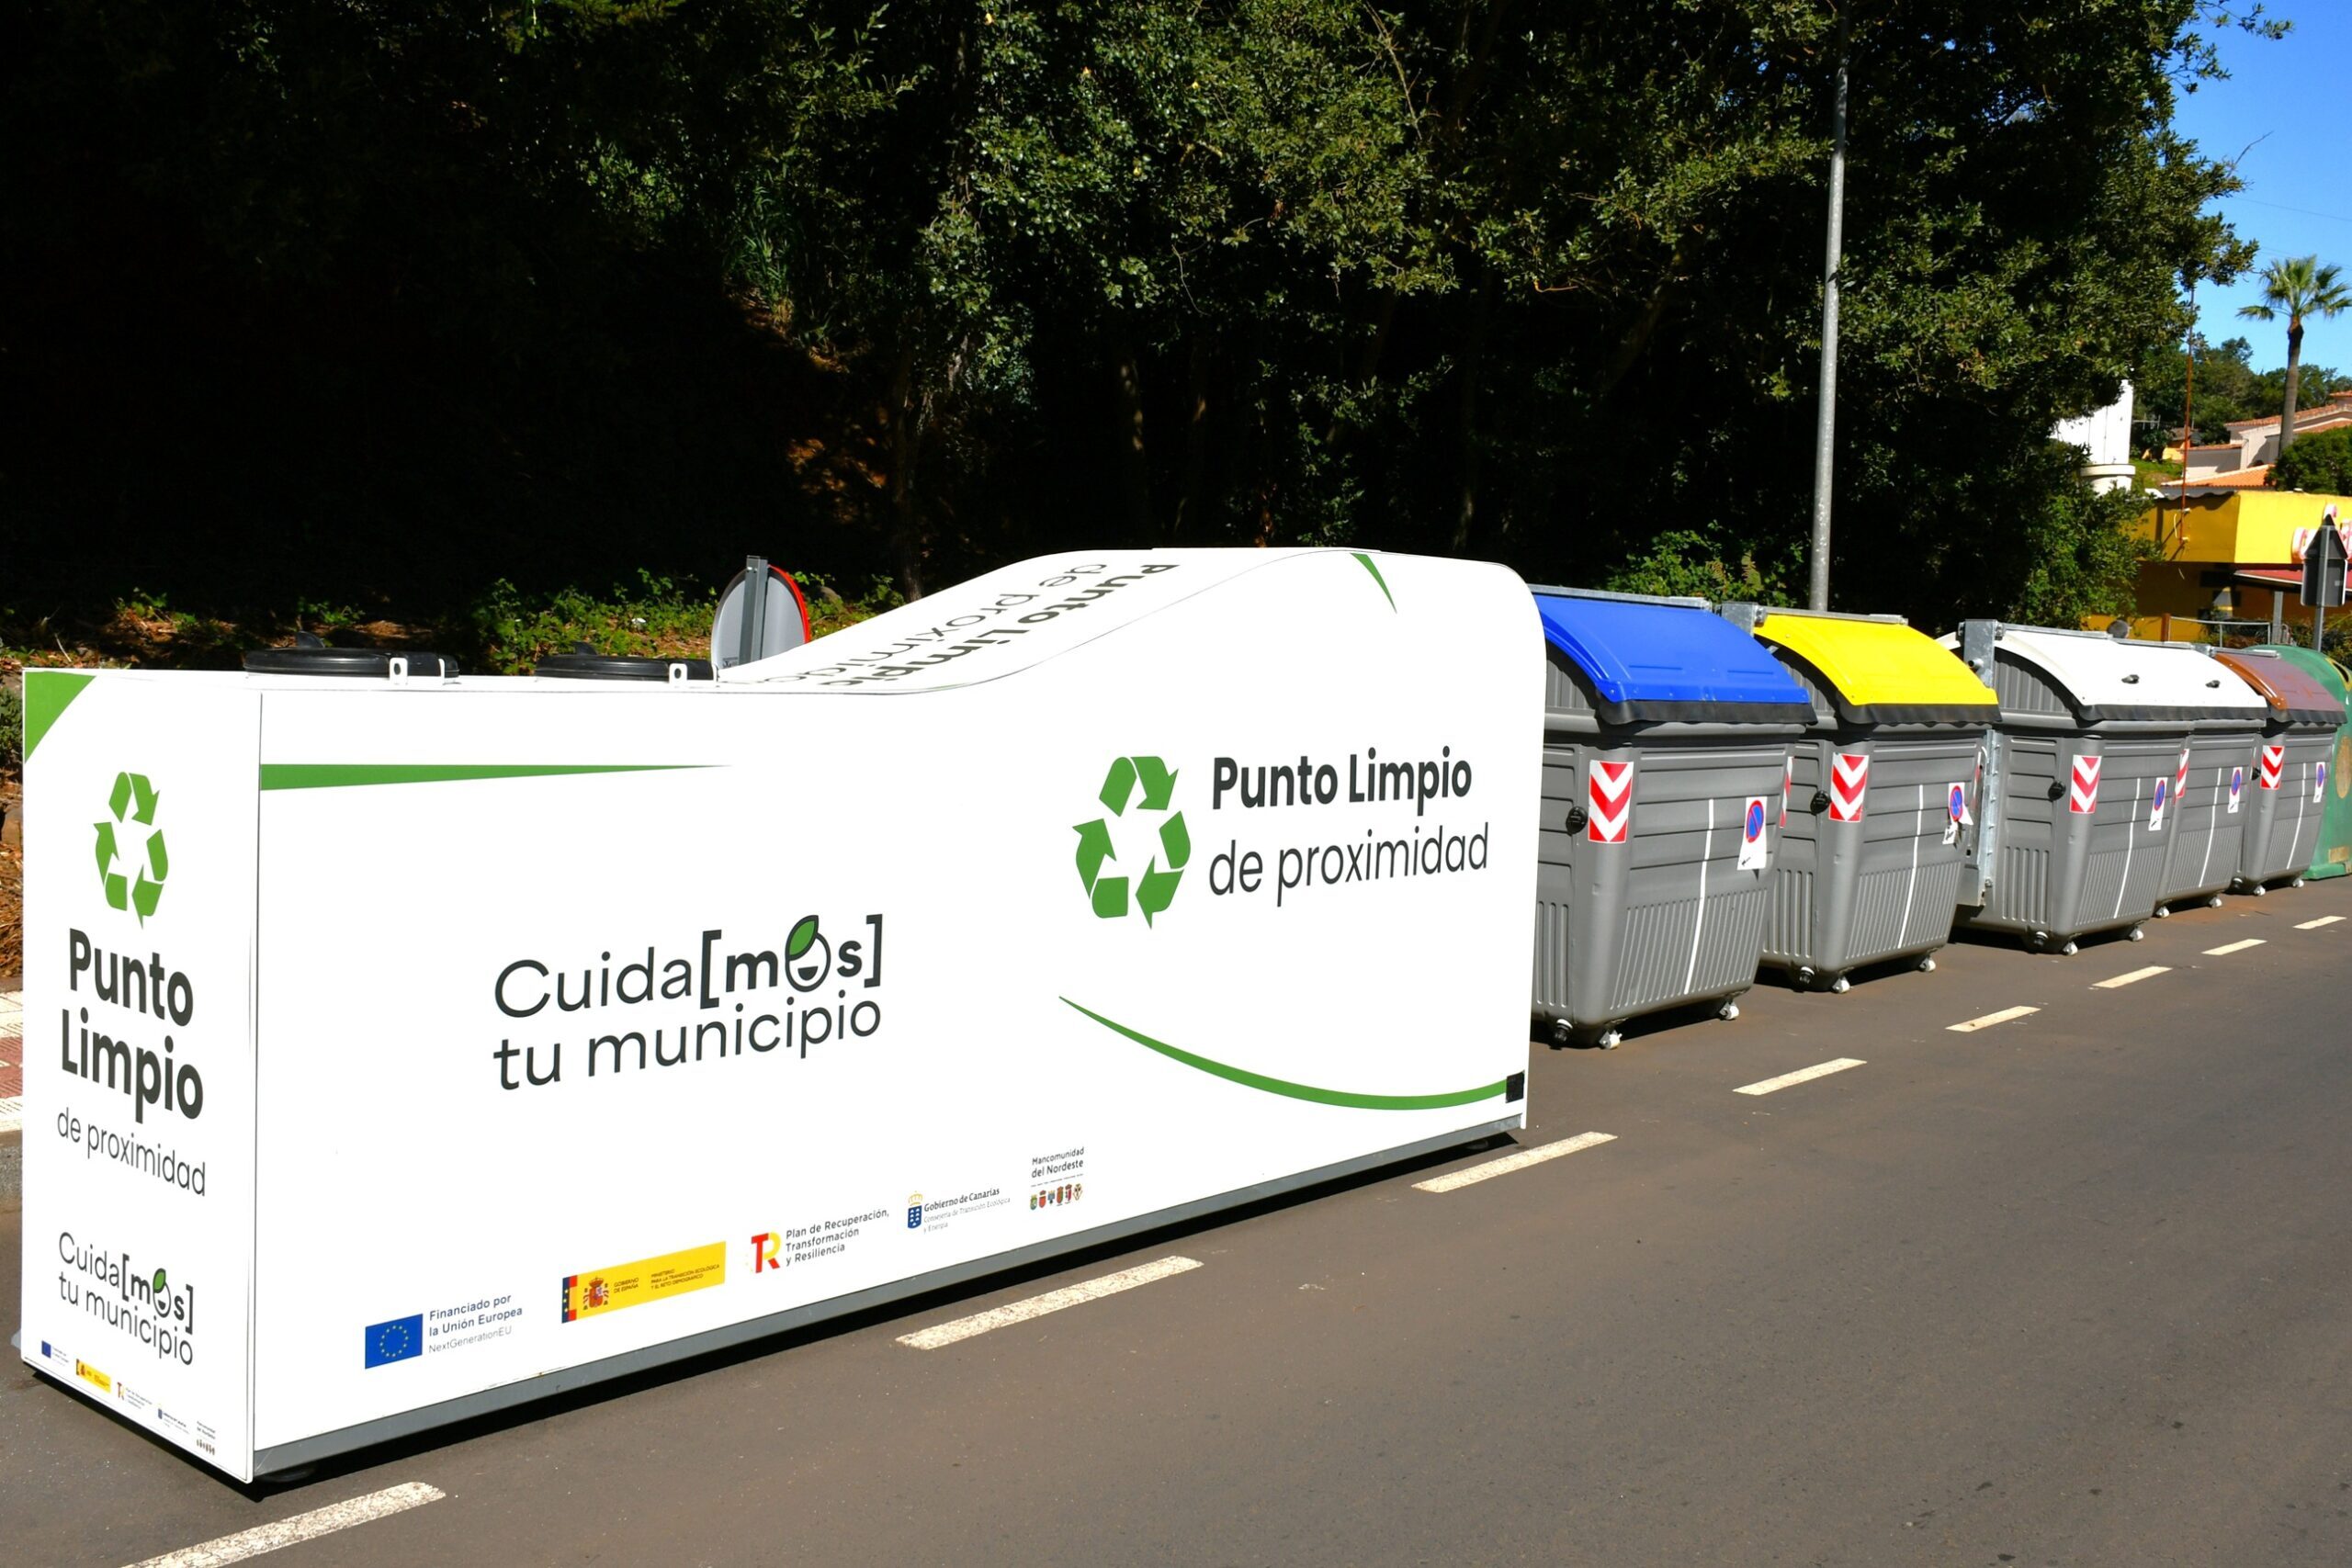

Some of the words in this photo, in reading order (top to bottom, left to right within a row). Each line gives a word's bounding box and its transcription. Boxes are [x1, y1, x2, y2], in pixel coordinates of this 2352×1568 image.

[1038, 564, 1107, 587] de
[1017, 564, 1181, 624] Punto
[1213, 756, 1339, 810] Punto
[1350, 746, 1472, 817] Limpio
[1209, 840, 1263, 896] de
[1277, 821, 1488, 908] proximidad
[70, 928, 194, 1027] Punto
[493, 1039, 560, 1090] tu
[588, 989, 881, 1077] municipio
[62, 1007, 204, 1124] Limpio
[57, 1107, 82, 1143] de
[87, 1123, 206, 1197] proximidad
[1032, 1146, 1084, 1166] Mancomunidad
[1031, 1167, 1045, 1179] del
[1046, 1159, 1084, 1175] Nordeste
[924, 1198, 958, 1213] Gobierno
[959, 1194, 968, 1203] de
[968, 1188, 1000, 1201] Canarias
[786, 1229, 807, 1240] Plan
[809, 1224, 821, 1235] de
[824, 1209, 889, 1231] Recuperación,
[786, 1227, 860, 1252] Transformación
[786, 1257, 792, 1267] y
[795, 1243, 845, 1263] Resiliencia
[58, 1270, 79, 1306] tu
[86, 1290, 193, 1365] municipio
[429, 1299, 491, 1322] Financiado
[493, 1295, 511, 1308] por
[429, 1327, 439, 1337] la
[442, 1318, 475, 1335] Unión
[478, 1307, 523, 1325] Europea
[428, 1325, 512, 1353] NextGenerationEU
